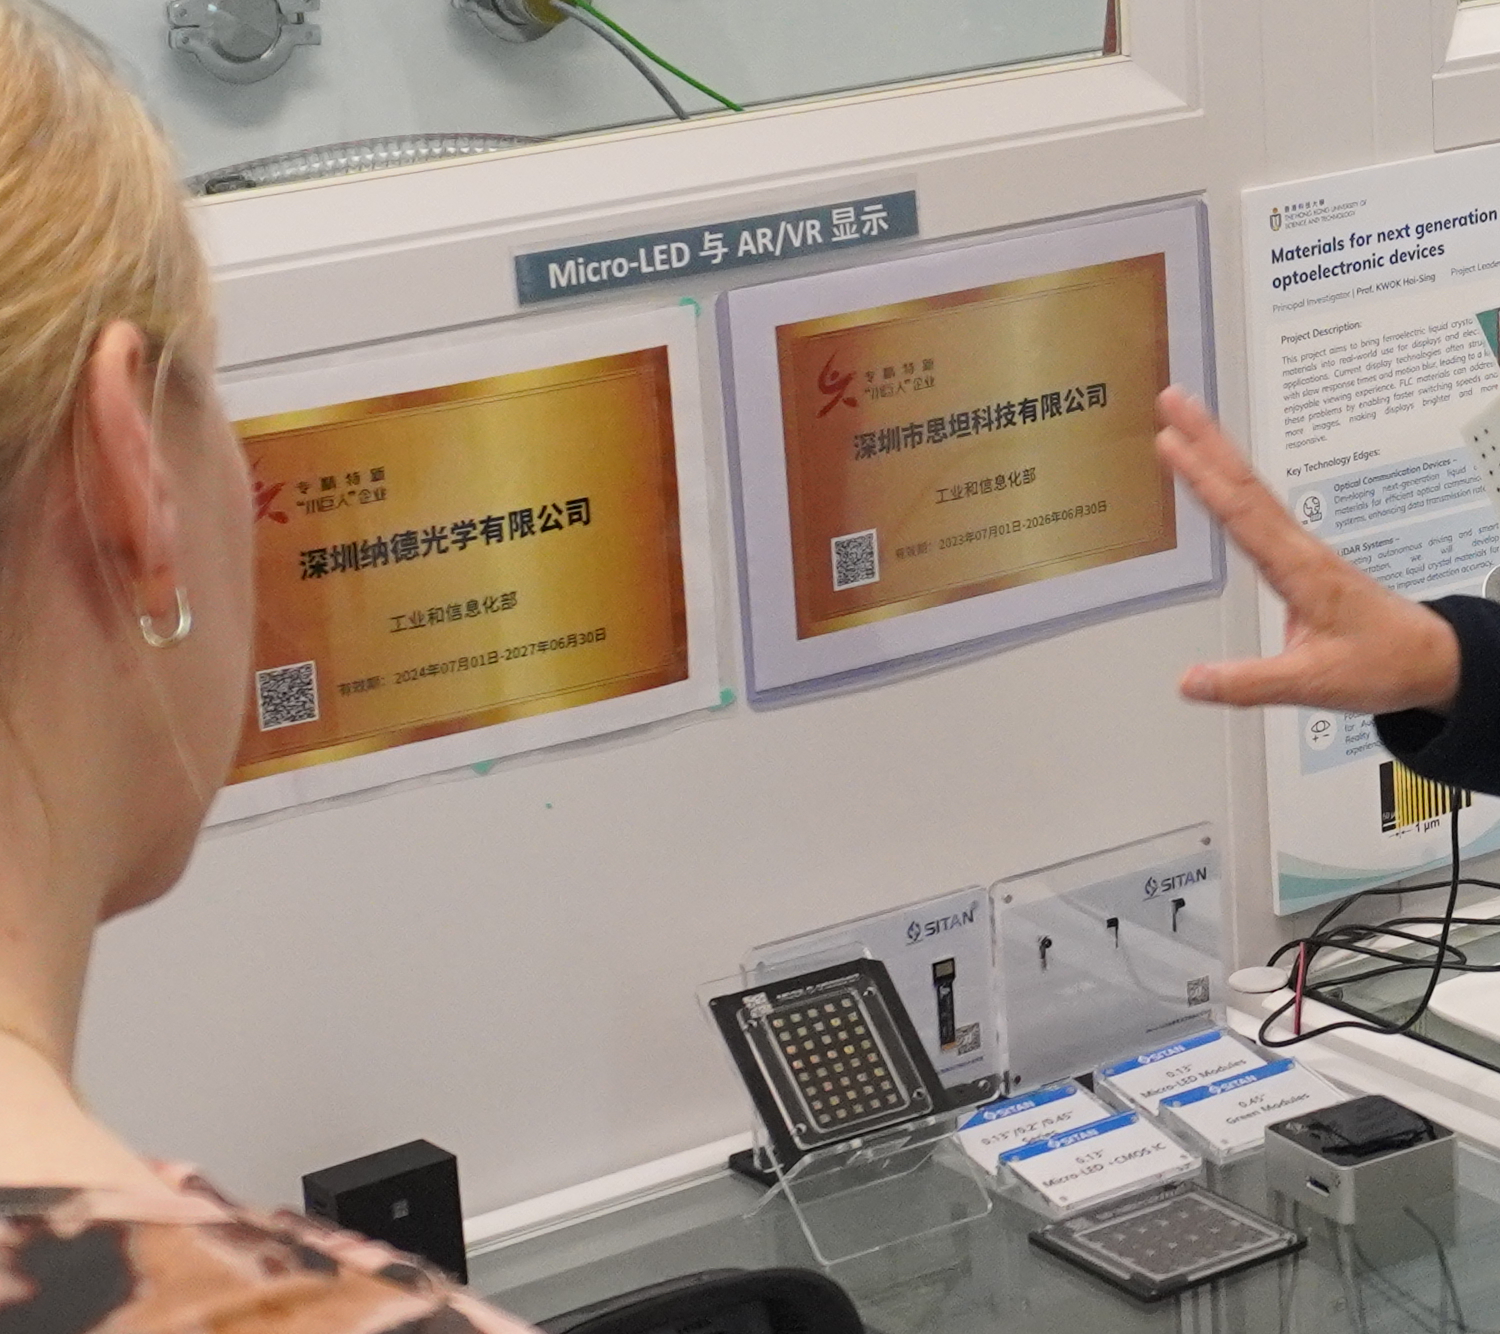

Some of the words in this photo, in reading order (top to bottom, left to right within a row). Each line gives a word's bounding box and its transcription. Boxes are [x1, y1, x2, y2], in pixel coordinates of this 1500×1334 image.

[548, 242, 690, 289] Micro-LED
[700, 232, 729, 265] 与
[737, 219, 823, 257] AR/VR
[831, 204, 889, 242] 显示
[1272, 237, 1345, 263] Materials
[1350, 233, 1373, 248] for
[1377, 223, 1411, 243] next
[1415, 210, 1498, 241] generation
[1272, 254, 1385, 290] optoelectronic
[1389, 244, 1445, 265] devices
[1452, 262, 1476, 276] Project
[1273, 298, 1304, 311] Principal
[1307, 290, 1351, 305] Investigator
[1357, 285, 1374, 296] Prof.
[1377, 280, 1401, 292] KWOK
[1281, 330, 1310, 344] Project
[1313, 322, 1362, 337] Description:
[1283, 362, 1317, 376] materials
[1412, 337, 1442, 349] displays
[1301, 348, 1327, 363] project
[1366, 359, 1392, 371] display
[1396, 349, 1441, 364] technologies
[1322, 380, 1355, 392] response
[1440, 355, 1466, 367] leading
[1284, 398, 1319, 413] enjoyable
[1417, 370, 1450, 384] materials
[854, 383, 1107, 461] 深圳市思坦科技有限公司
[1308, 407, 1342, 422] problems
[1287, 467, 1301, 477] Key
[1304, 456, 1351, 472] Technology
[1354, 449, 1380, 462] Edges:
[1334, 478, 1360, 494] Optical
[1363, 467, 1420, 485] Communication
[1423, 460, 1450, 471] Devices
[936, 468, 1036, 504] 工业和信息化部
[1382, 474, 1440, 492] next-generation
[1427, 490, 1471, 506] transmission
[300, 497, 591, 581] 深圳纳德光学有限公司
[939, 500, 1107, 551] 2023年07月01日-2026年06月30日
[1363, 538, 1394, 552] Systems
[1378, 544, 1422, 558] autonomous
[390, 591, 518, 633] 工业和信息化部
[394, 627, 606, 685] 2024年07月01日-2027年06月30日
[1345, 731, 1370, 744] Reality
[1415, 824, 1420, 832] 1
[1160, 867, 1207, 894] SITAN
[924, 907, 974, 938] SITAN
[1150, 1045, 1185, 1062] SITAN
[1140, 1075, 1198, 1098] Micro-LED
[1200, 1058, 1247, 1079] Modules
[1221, 1075, 1258, 1093] SITAN
[998, 1100, 1035, 1117] SITAN
[1226, 1107, 1259, 1125] Green
[1261, 1093, 1311, 1115] Modules
[1060, 1128, 1099, 1145] SITAN
[1042, 1163, 1104, 1188] Micro-LED
